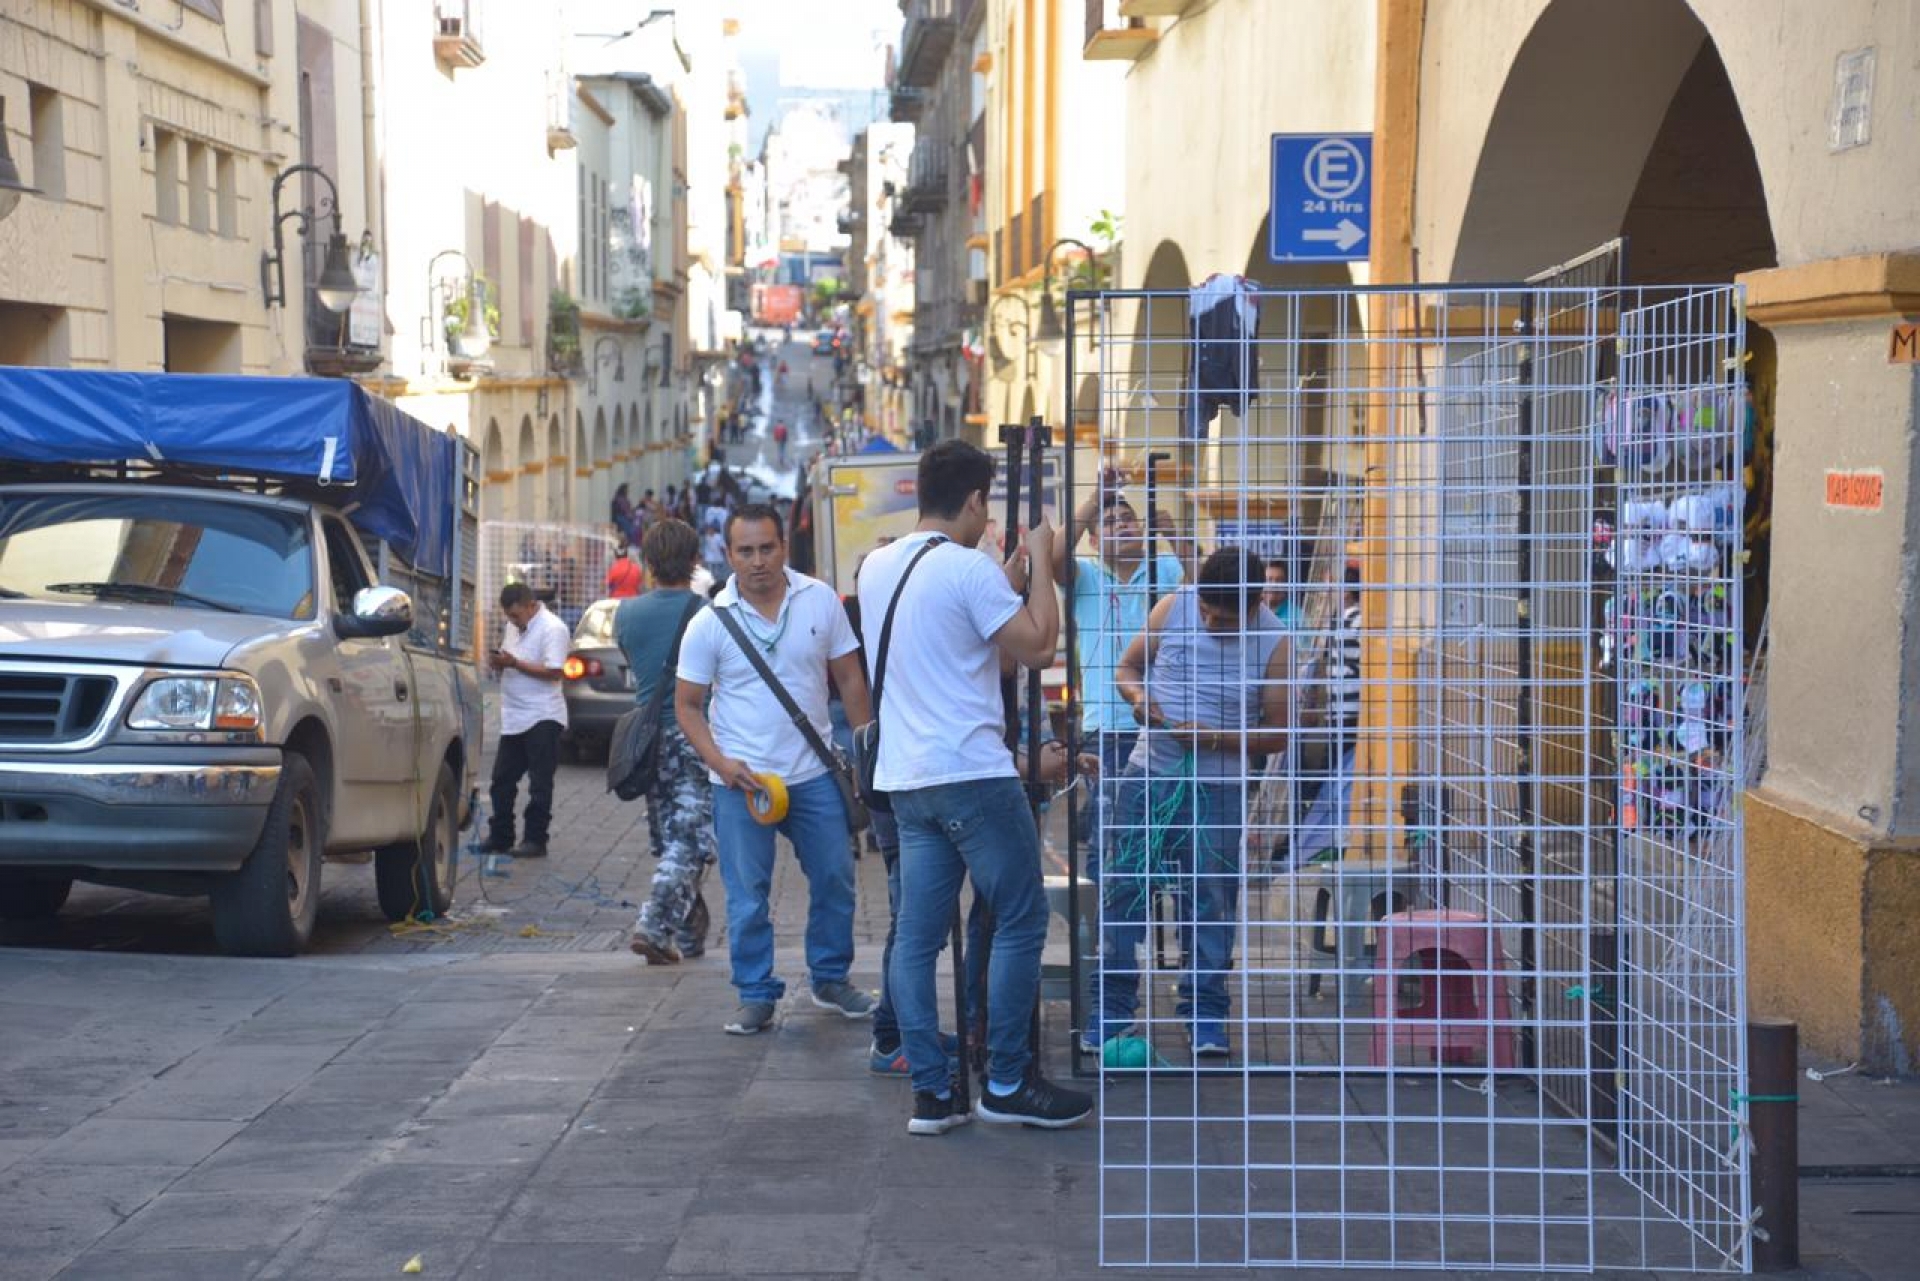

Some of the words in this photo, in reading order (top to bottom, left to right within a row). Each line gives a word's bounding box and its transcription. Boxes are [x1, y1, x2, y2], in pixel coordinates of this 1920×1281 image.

[1318, 149, 1349, 188] E
[1302, 200, 1326, 213] 24
[1331, 200, 1364, 213] Hrs
